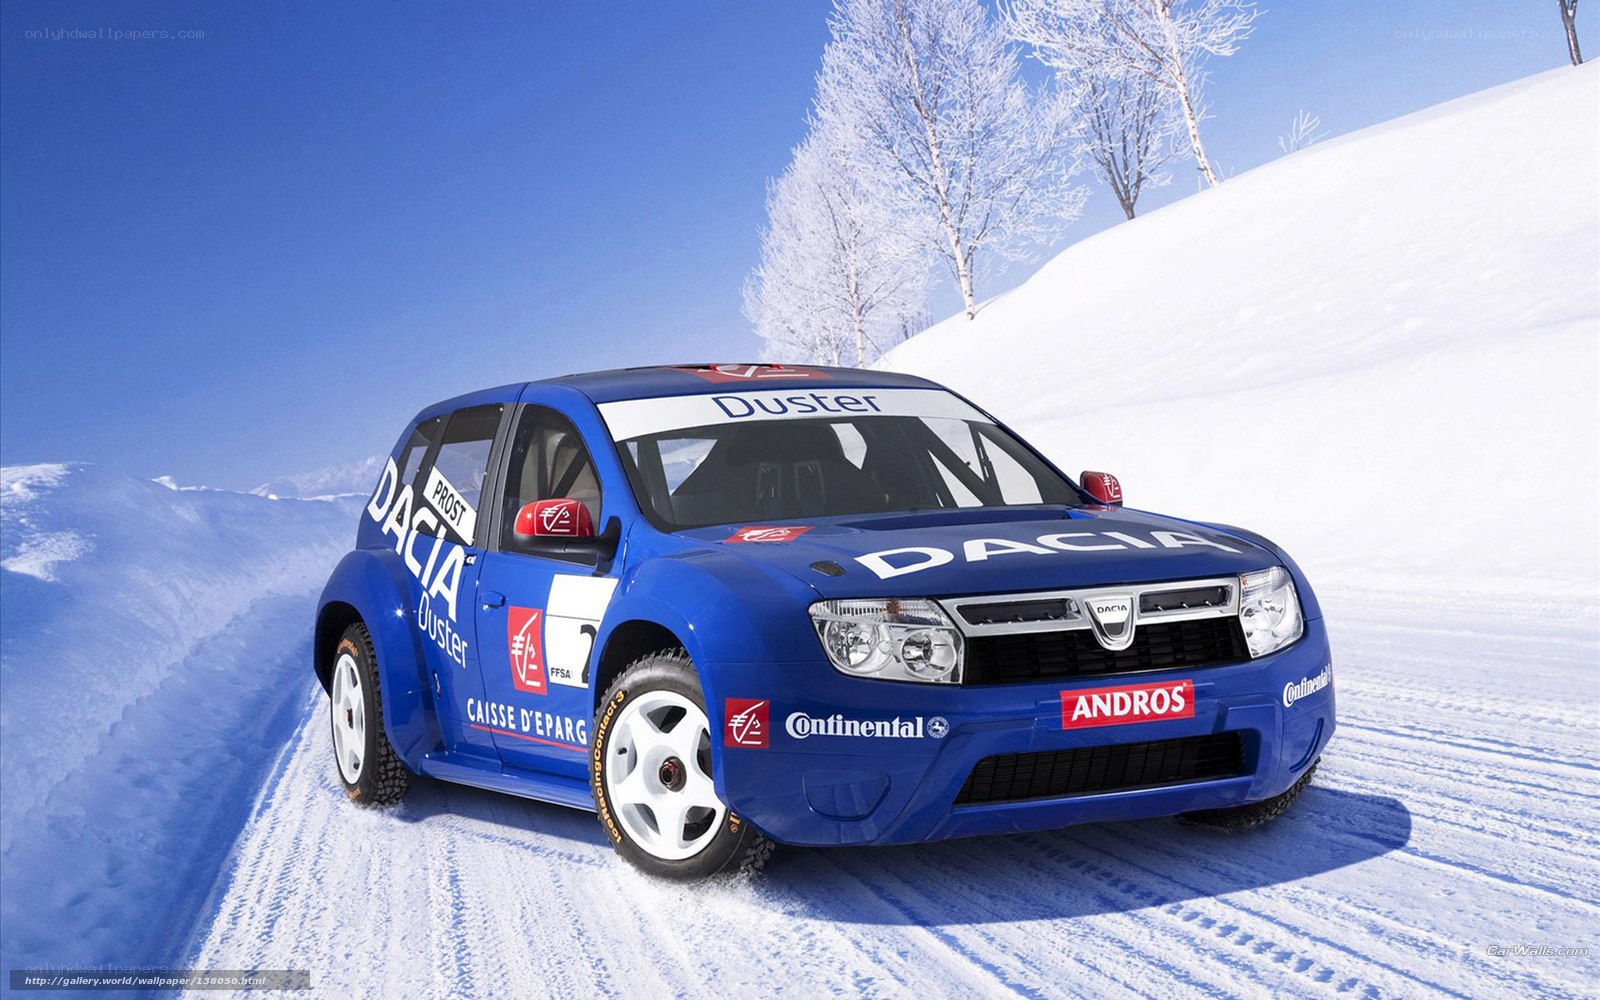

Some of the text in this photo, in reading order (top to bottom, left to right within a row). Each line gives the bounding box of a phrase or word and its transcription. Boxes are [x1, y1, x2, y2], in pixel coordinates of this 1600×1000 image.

[711, 392, 881, 419] Duster
[433, 478, 467, 529] PROST
[367, 456, 466, 623] DACIA
[854, 531, 1242, 580] DACIA
[1096, 604, 1128, 614] DACIA
[418, 590, 468, 669] Duster
[550, 666, 571, 679] FFSA
[1283, 665, 1329, 708] Continental
[467, 697, 517, 730] CAISSE
[1071, 684, 1186, 722] ANDROS
[785, 711, 925, 740] Continental
